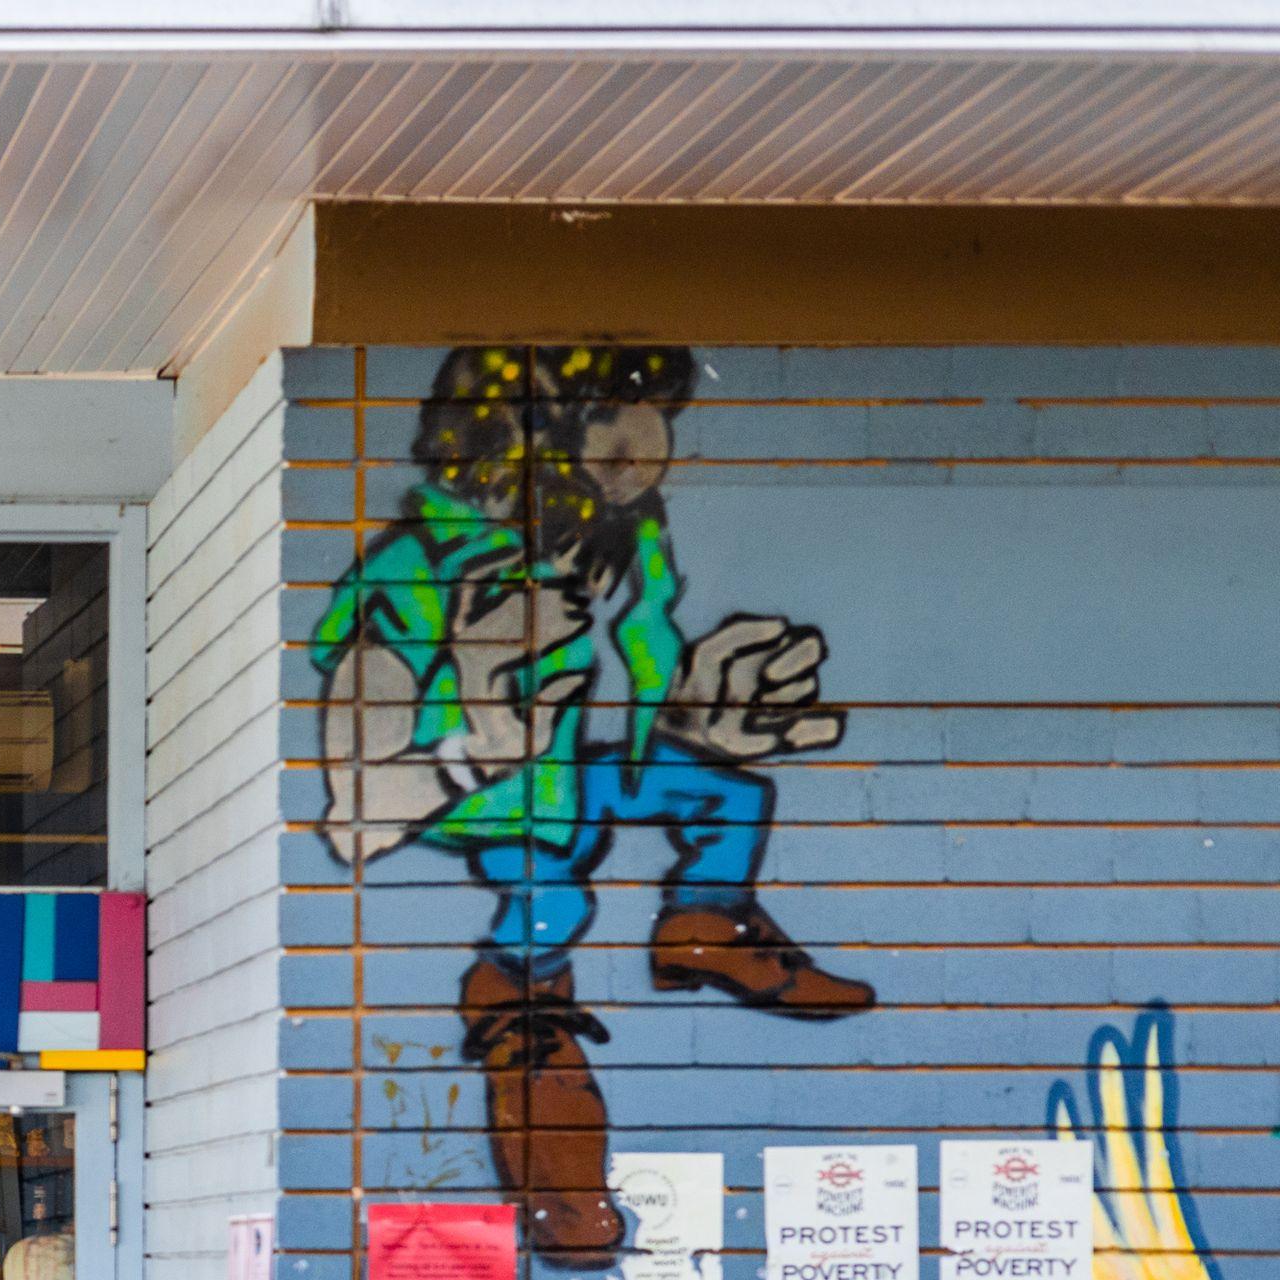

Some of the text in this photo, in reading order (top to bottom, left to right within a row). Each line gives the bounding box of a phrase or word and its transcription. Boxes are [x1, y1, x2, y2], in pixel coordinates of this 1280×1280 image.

[780, 1225, 904, 1244] PROTEST
[955, 1220, 1079, 1239] PROTEST
[956, 1258, 1077, 1276] POVERTY
